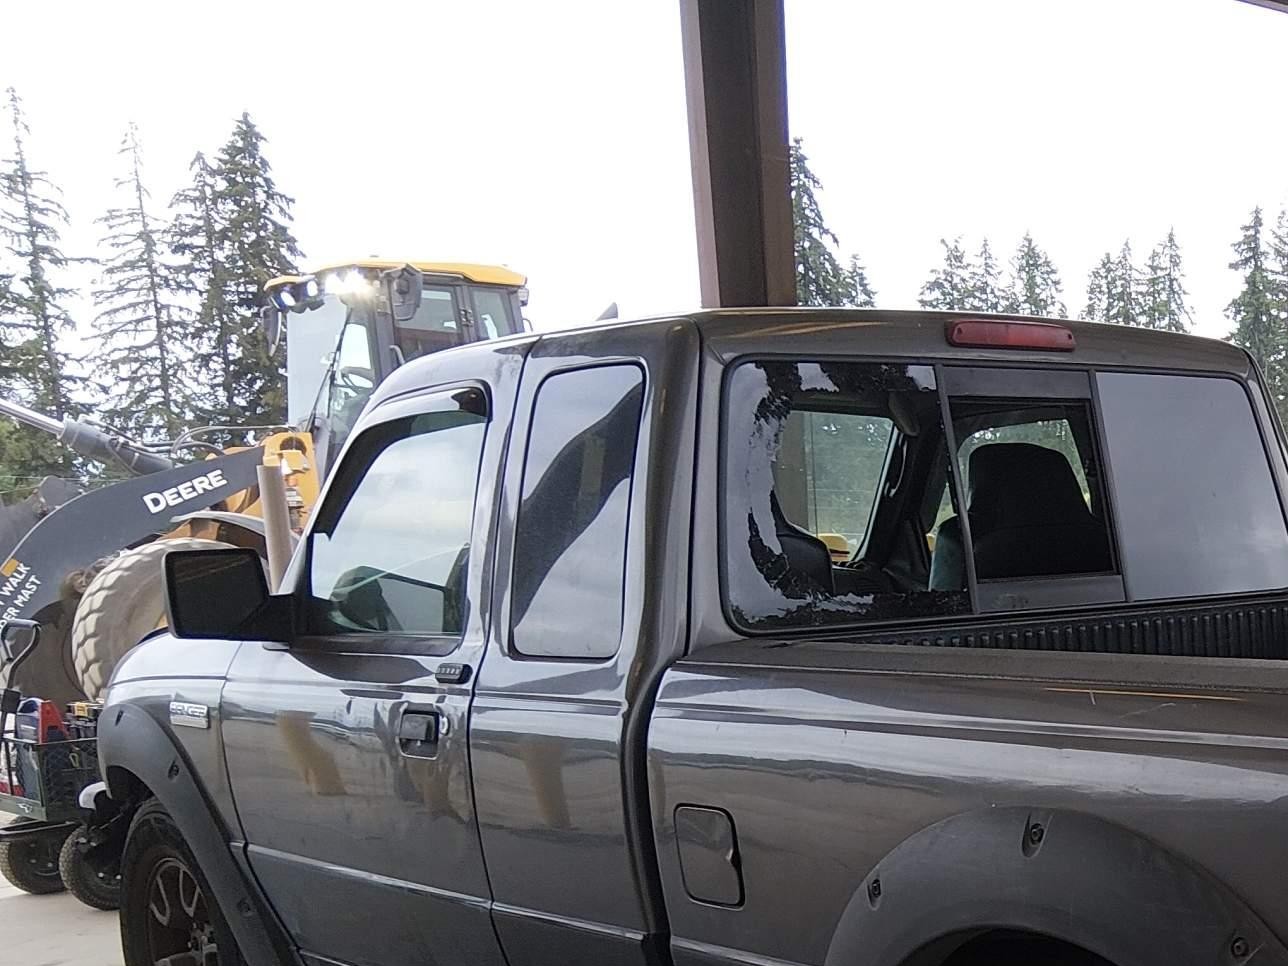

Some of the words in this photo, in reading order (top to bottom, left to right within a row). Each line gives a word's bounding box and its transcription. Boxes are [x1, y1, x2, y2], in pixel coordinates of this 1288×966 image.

[142, 469, 229, 514] DEERE
[0, 562, 32, 597] WALK
[13, 574, 43, 607] MAST
